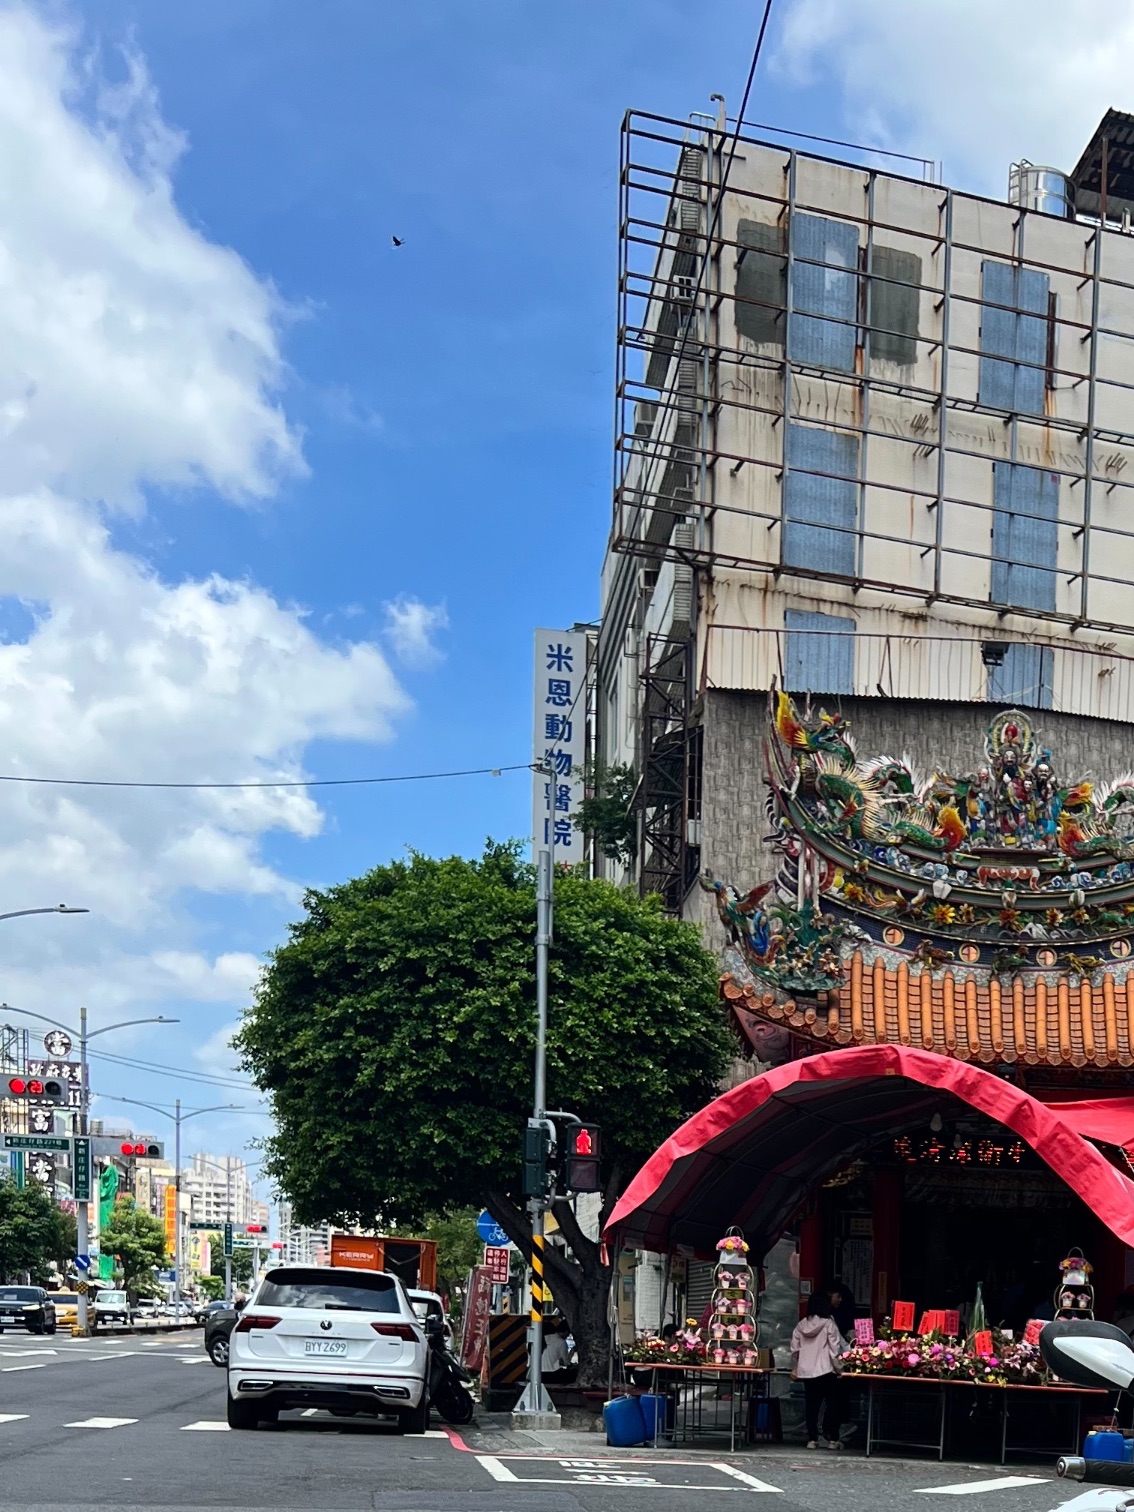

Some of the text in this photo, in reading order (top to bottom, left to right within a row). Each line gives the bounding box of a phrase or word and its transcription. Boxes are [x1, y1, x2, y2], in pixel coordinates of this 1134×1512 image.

[544, 643, 574, 848] 米恩動物醫院
